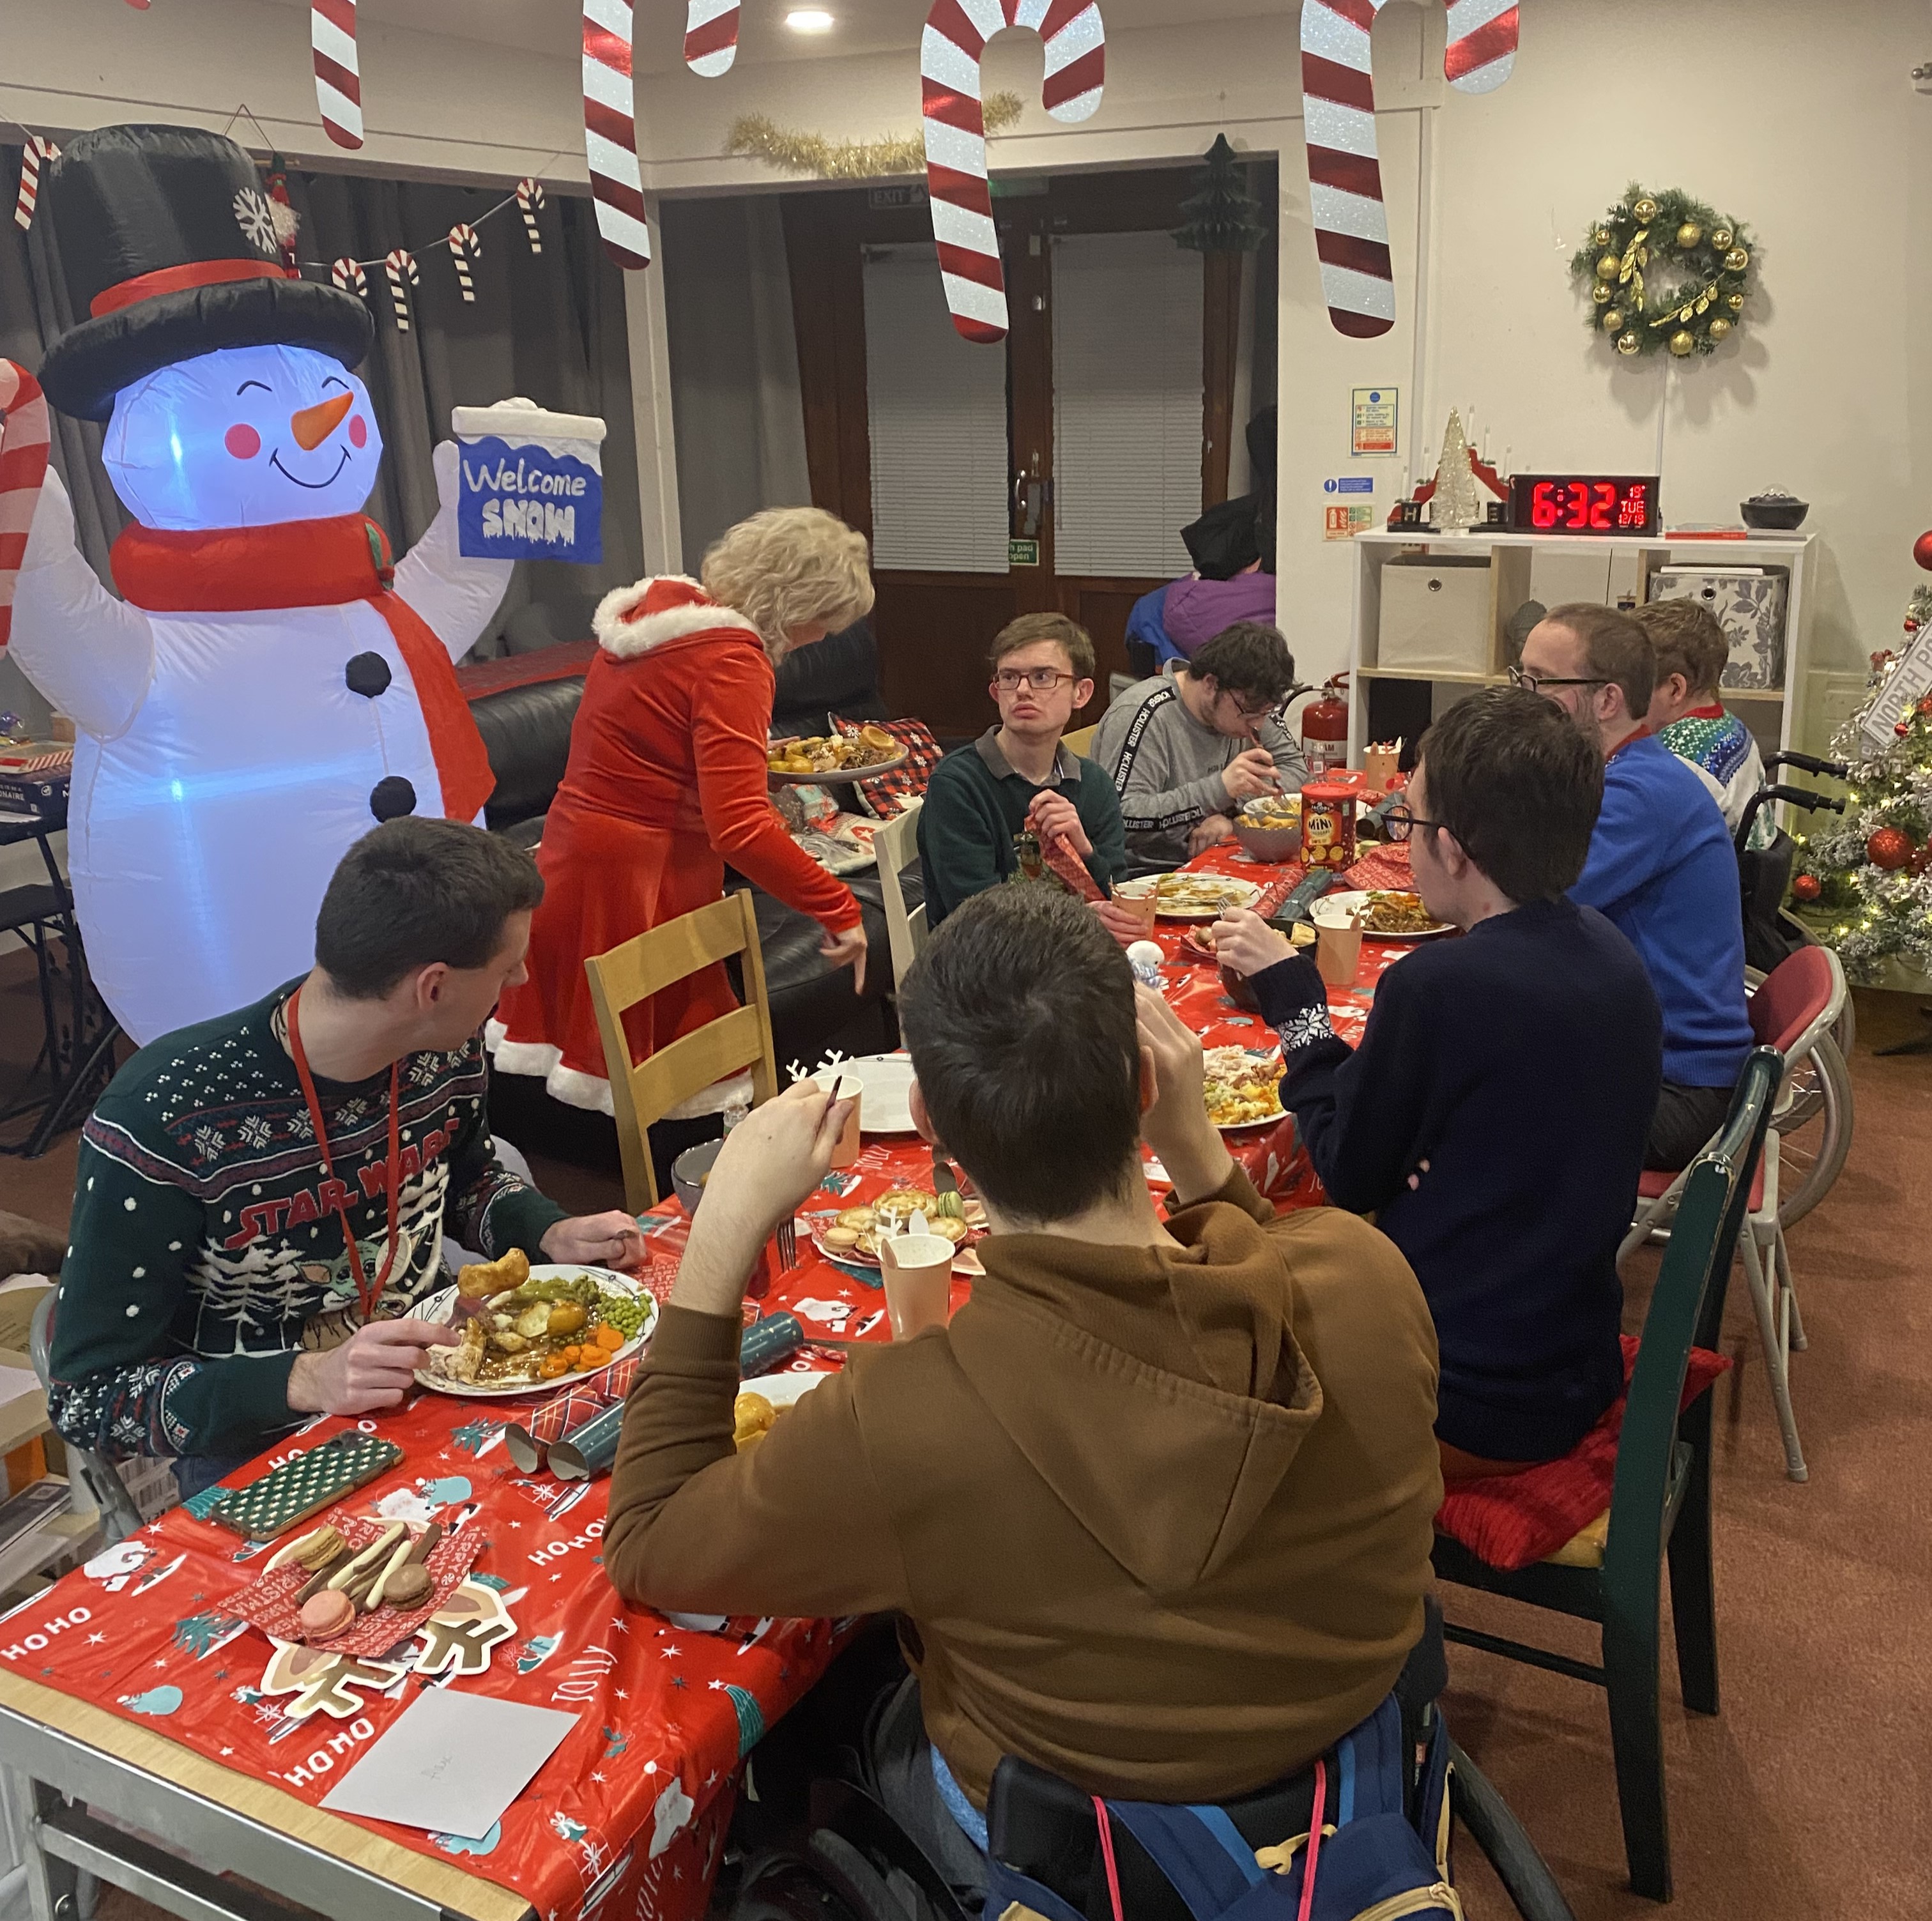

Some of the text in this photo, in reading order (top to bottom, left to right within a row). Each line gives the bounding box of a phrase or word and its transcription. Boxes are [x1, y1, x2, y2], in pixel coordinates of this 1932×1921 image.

[463, 457, 586, 496] Welcome
[482, 498, 575, 547] SNOW
[1532, 482, 1616, 528] 6:32
[1618, 514, 1644, 525] 12/19
[1621, 500, 1644, 514] TUE
[1871, 667, 1926, 736] NORTH
[224, 1179, 358, 1250] STAR
[0, 1605, 93, 1661] HO HO
[551, 1644, 618, 1703] JOLLY
[283, 1717, 376, 1787] HO HO
